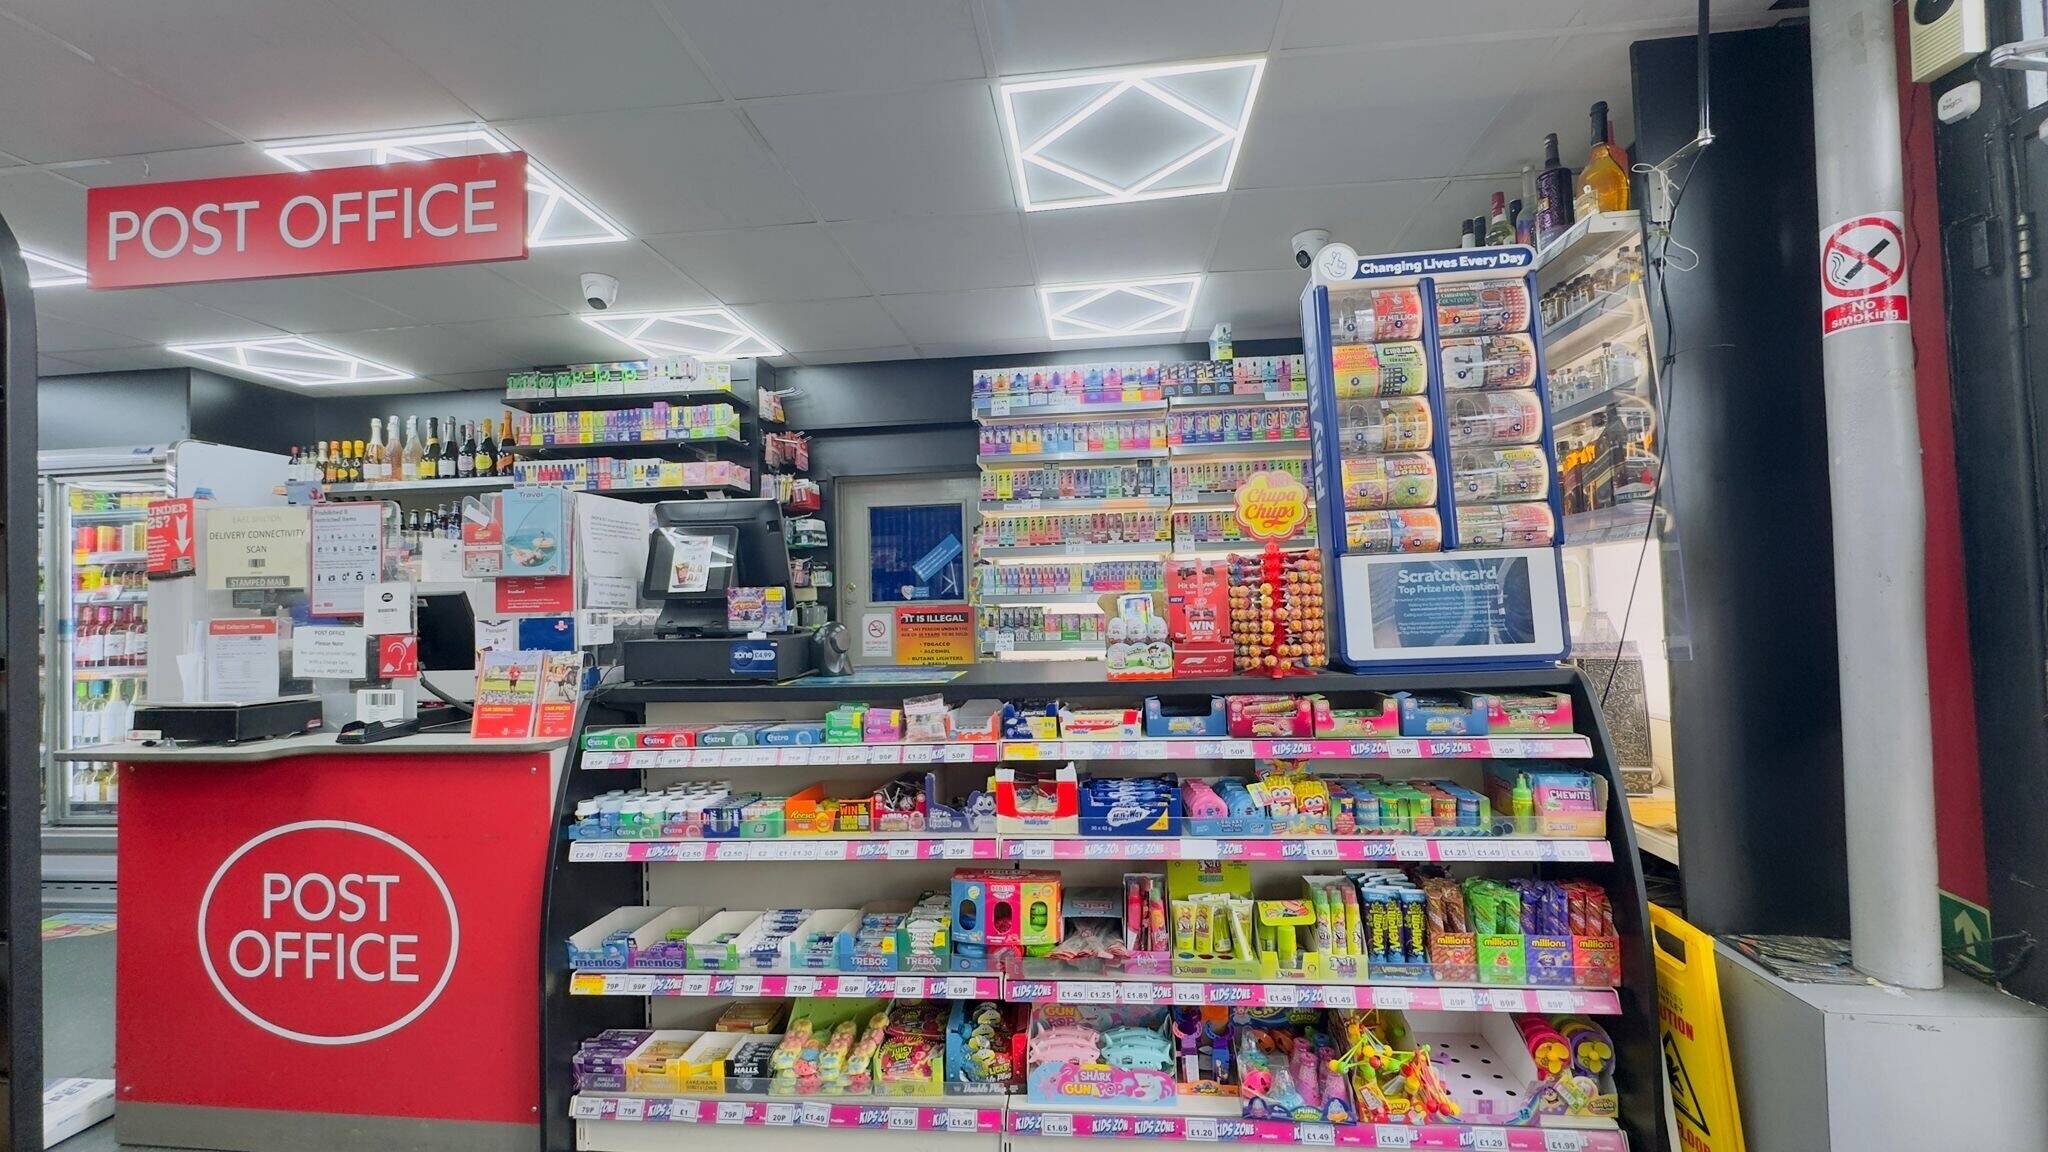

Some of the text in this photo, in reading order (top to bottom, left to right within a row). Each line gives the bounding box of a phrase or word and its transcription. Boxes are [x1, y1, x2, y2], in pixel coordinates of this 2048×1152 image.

[108, 180, 498, 261] POST OFFICE
[1360, 251, 1525, 275] Changing Lives Every Day
[1851, 299, 1877, 312] No
[1831, 307, 1899, 329] smoking
[1247, 487, 1297, 504] Chupa
[148, 503, 187, 516] UNDER
[1245, 504, 1296, 521] Chups
[148, 515, 170, 529] 25?
[209, 529, 305, 541] DELIVERY CONNECTIVITY
[246, 546, 267, 554] SCAN
[1398, 566, 1497, 583] Scratchcard
[230, 578, 286, 587] STAMPED MAIL
[1398, 582, 1500, 595] Top Prize Information
[926, 614, 964, 622] ILLEGAL
[1189, 620, 1215, 631] WIN
[733, 650, 753, 659] zone
[587, 737, 609, 747] extra
[643, 735, 665, 745] extra
[703, 734, 726, 745] extra
[767, 733, 789, 744] extra
[1271, 742, 1312, 756] KIDS ZONE
[1350, 743, 1369, 756] KIDS
[1430, 741, 1473, 755] KIDS ZONE
[841, 804, 858, 815] WIN
[1282, 844, 1305, 857] KIDS
[263, 873, 400, 922] POST
[1437, 936, 1471, 945] millions
[1484, 937, 1518, 947] millions
[1531, 938, 1566, 948] millions
[1579, 939, 1614, 949] millions
[228, 929, 419, 982] OFFICE
[575, 958, 622, 967] mentos
[635, 957, 681, 968] mentos
[850, 957, 888, 966] TREBOR
[905, 957, 942, 966] TREBOR
[844, 985, 859, 993] 69P
[953, 986, 968, 994] 69P
[1012, 984, 1052, 998] KIDS ZONE
[1210, 987, 1252, 1001] KIDS ZONE
[1269, 994, 1292, 1002] £1.49
[1044, 1005, 1075, 1015] GUN
[1049, 1018, 1075, 1026] POP
[734, 1066, 759, 1075] HALLS
[1079, 1070, 1111, 1081] SHARK
[1063, 1083, 1125, 1096] GUN POP
[680, 1108, 689, 1116] £1
[723, 1110, 738, 1118] 79P
[805, 1114, 825, 1123] £1.49
[859, 1111, 878, 1125] KIDS
[893, 1118, 914, 1126] £1.99
[1015, 1116, 1035, 1130] KIDS
[1092, 1119, 1114, 1133] KIDS
[1134, 1120, 1176, 1134] KIDS ZONE
[1233, 1123, 1255, 1135] ZONE
[1190, 1129, 1213, 1137] £1.20
[1306, 1132, 1329, 1141] £1.49
[1381, 1135, 1405, 1144] £1.49
[1479, 1138, 1503, 1148] £1.29
[1551, 1140, 1576, 1150] £1.99
